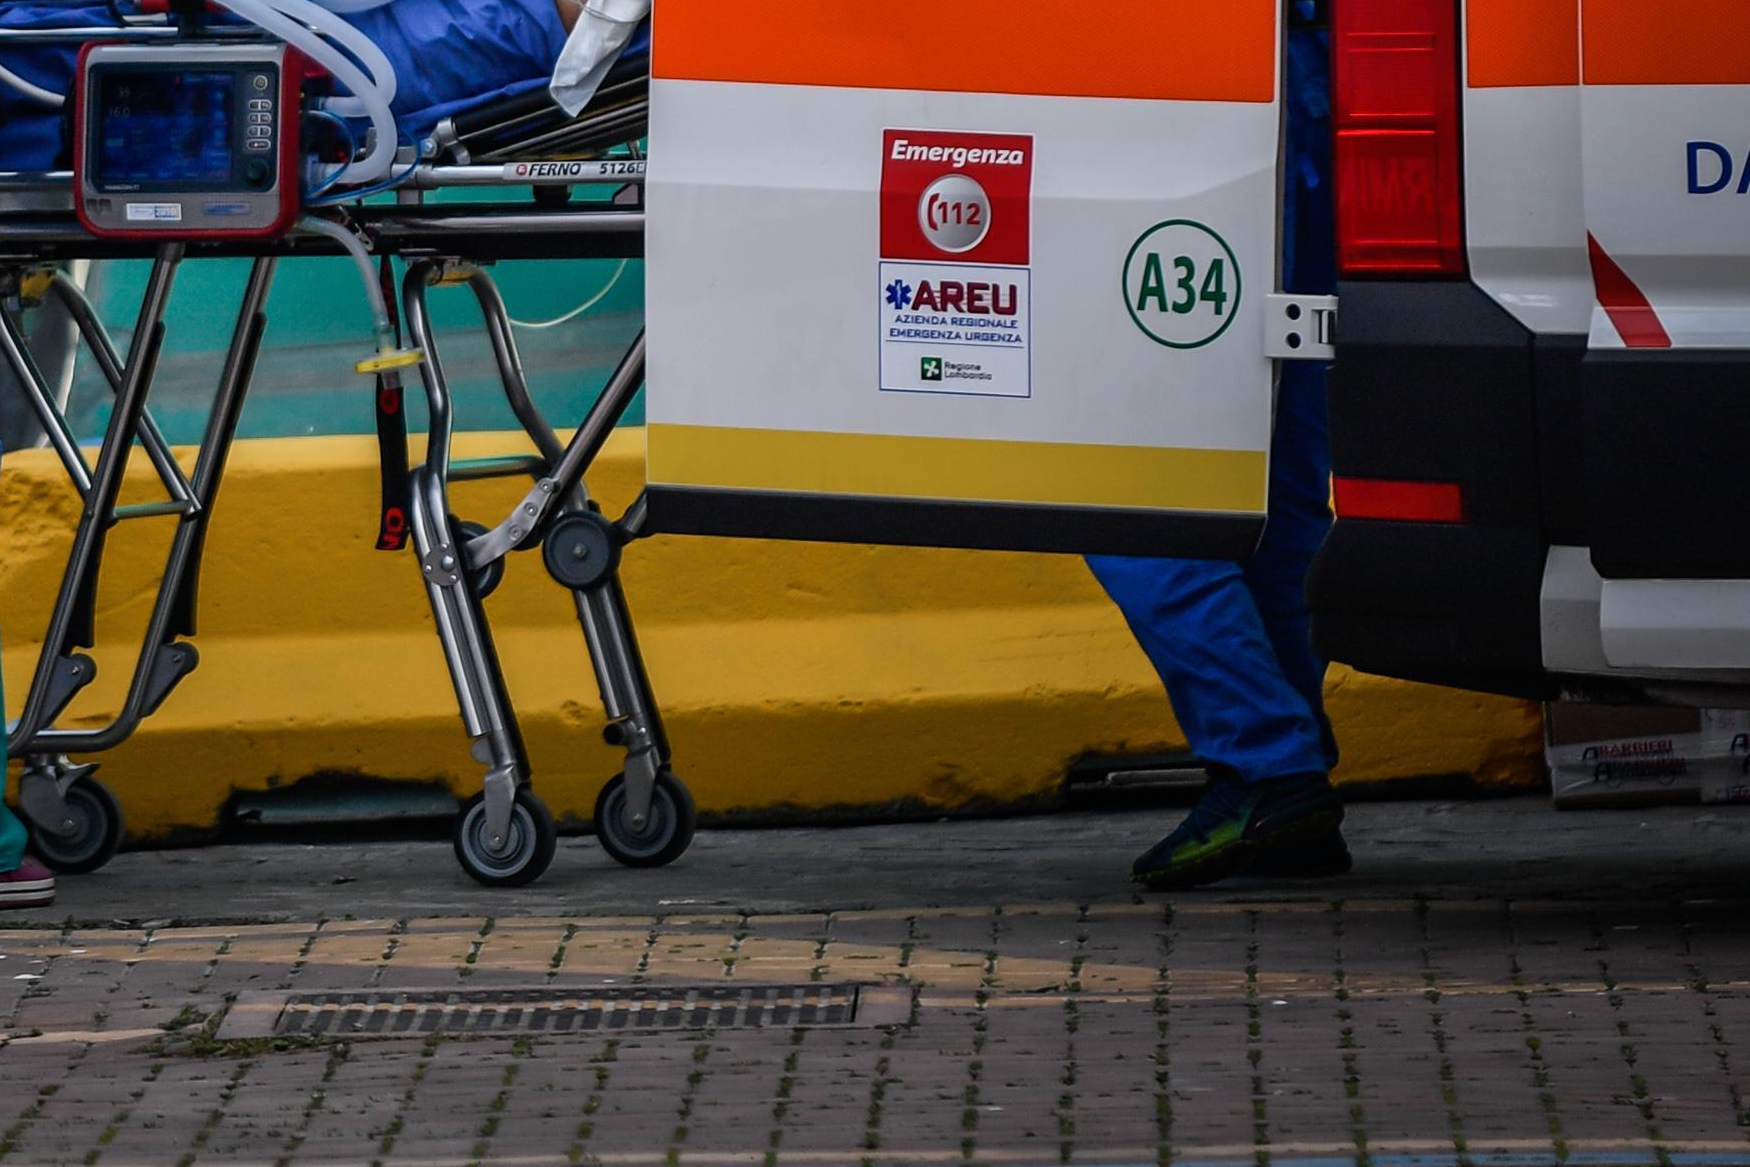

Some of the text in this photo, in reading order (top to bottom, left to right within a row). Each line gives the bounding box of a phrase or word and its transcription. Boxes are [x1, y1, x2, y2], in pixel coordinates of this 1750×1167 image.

[891, 139, 1024, 168] Emergenza
[529, 162, 581, 177] FERNO
[1687, 141, 1750, 195] D
[937, 201, 981, 225] 112
[1136, 253, 1228, 316] A34
[911, 280, 1018, 316] AREU
[895, 314, 1019, 330] AZIENDA REGIONALE
[889, 328, 1023, 344] EMERGENZA URGENZA
[944, 361, 982, 374] Regione
